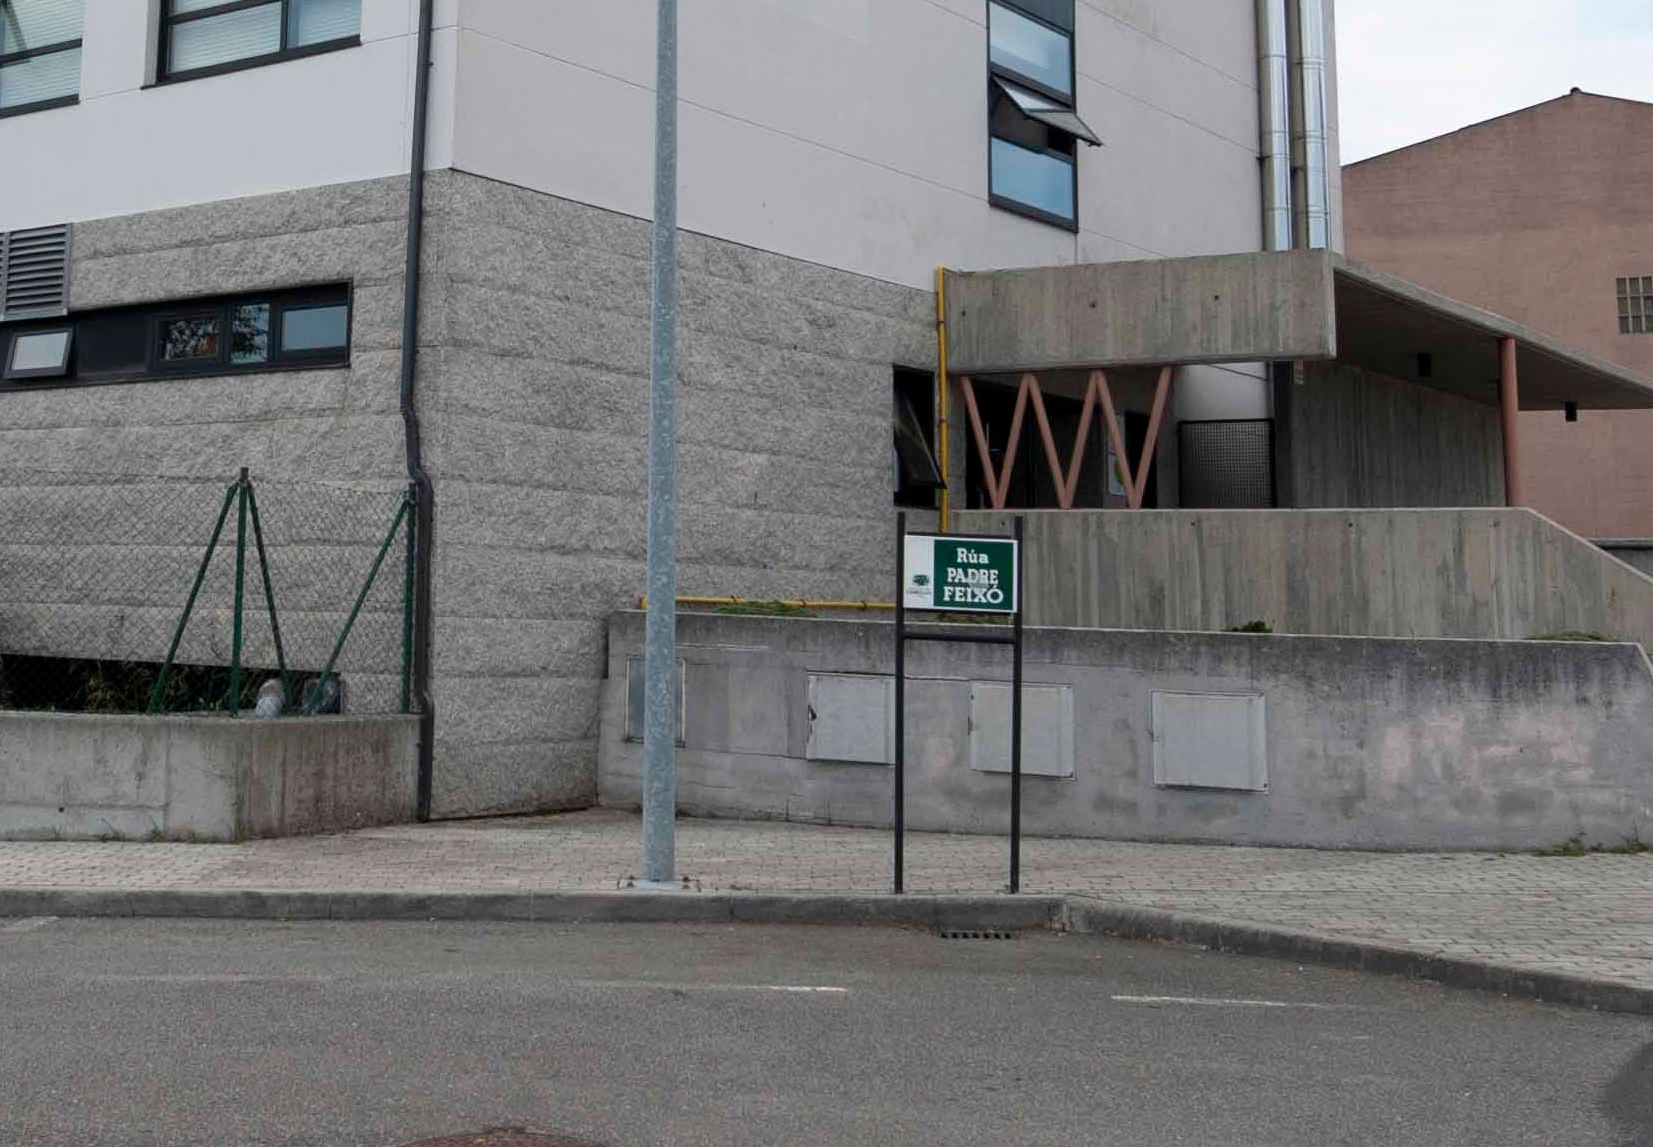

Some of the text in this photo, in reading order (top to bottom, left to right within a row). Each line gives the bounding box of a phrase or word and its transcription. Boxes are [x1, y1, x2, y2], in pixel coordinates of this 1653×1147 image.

[956, 547, 989, 564] Rúa
[946, 567, 999, 585] PADRE
[943, 585, 1004, 604] FEIXÓ
